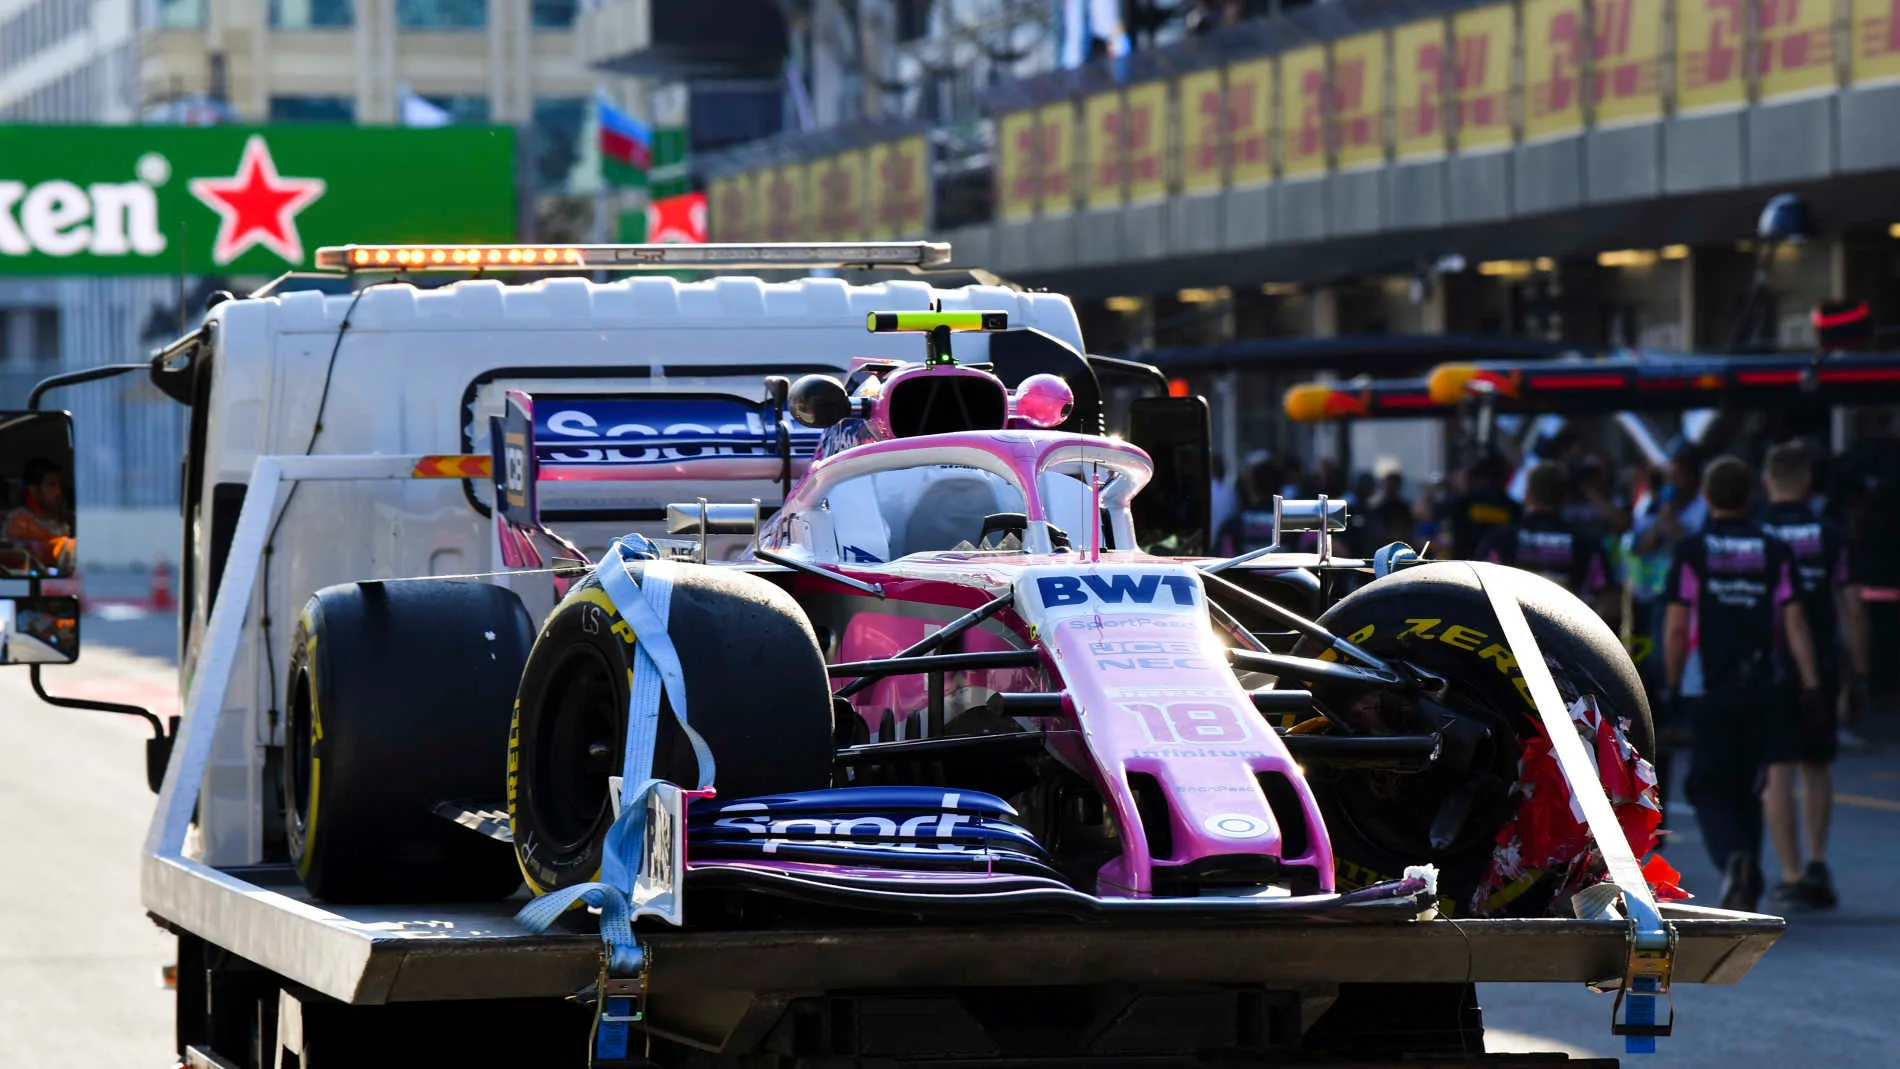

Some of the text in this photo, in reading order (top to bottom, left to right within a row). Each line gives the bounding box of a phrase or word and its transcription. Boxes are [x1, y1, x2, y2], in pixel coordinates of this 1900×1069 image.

[1037, 574, 1198, 608] BWT
[1098, 657, 1209, 670] NEC
[1118, 703, 1251, 745] 18
